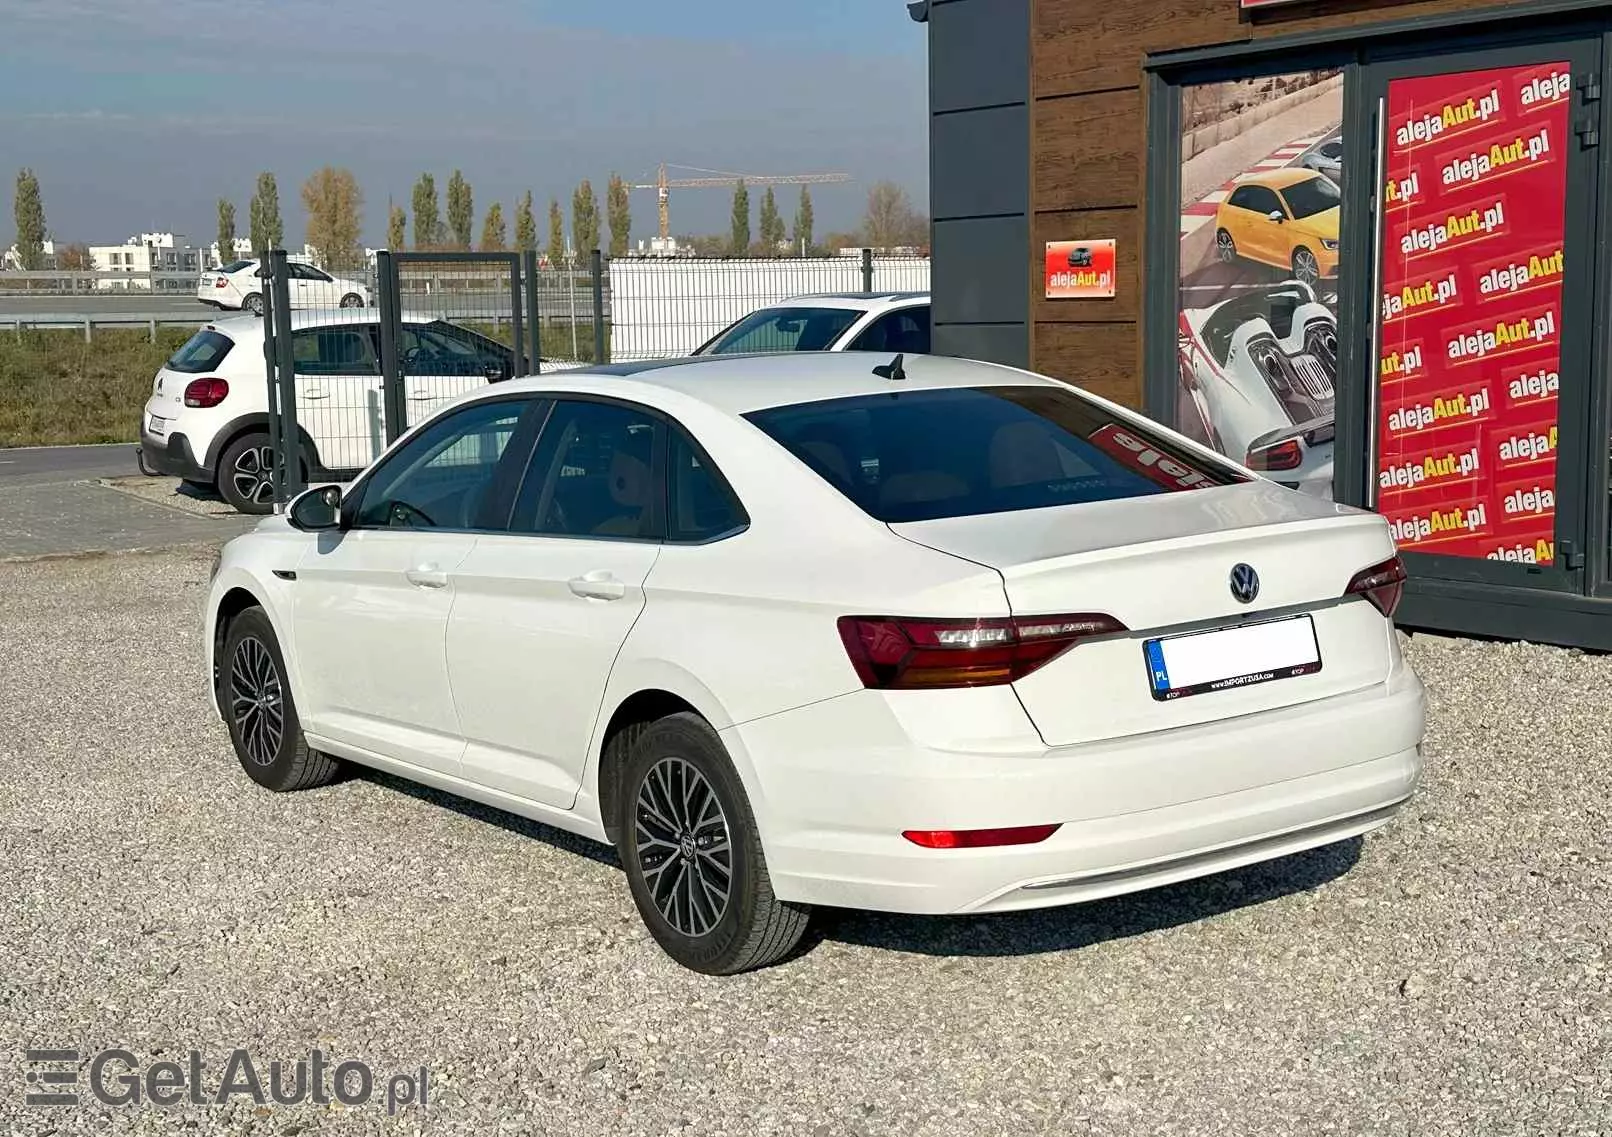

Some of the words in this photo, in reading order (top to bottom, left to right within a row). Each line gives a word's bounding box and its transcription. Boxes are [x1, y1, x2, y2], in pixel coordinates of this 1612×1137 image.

[1520, 72, 1570, 105] aleja
[1397, 89, 1499, 145] alejaAut.pl
[1442, 129, 1549, 184] alejaAut.pl
[1401, 202, 1504, 253] alejaAut.pl
[1050, 270, 1111, 288] alejaAut.pl
[1479, 250, 1564, 293] alejaAut
[1448, 311, 1555, 358] alejaAut.pl
[1509, 369, 1559, 399] aleja
[1388, 388, 1490, 431] alejaAut.pl
[1379, 448, 1480, 488] alejaAut.pl
[1504, 486, 1554, 514] aleja
[1156, 671, 1168, 682] PL
